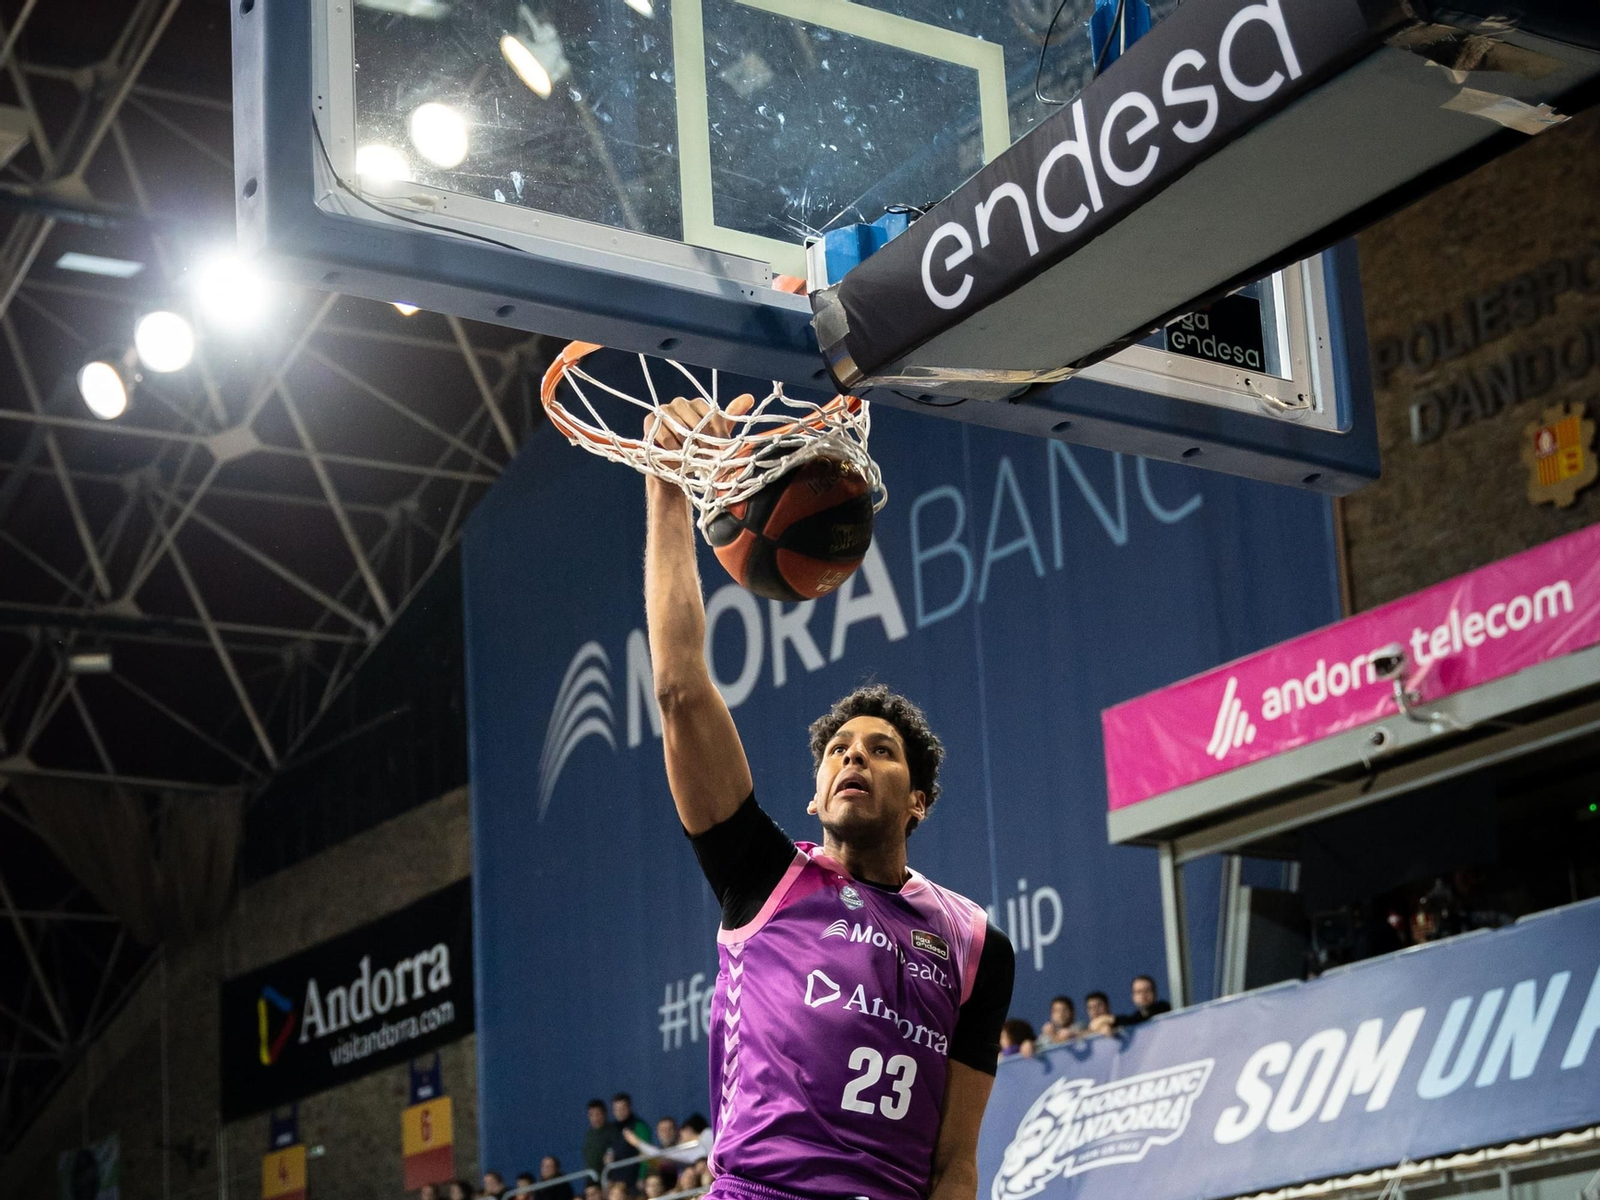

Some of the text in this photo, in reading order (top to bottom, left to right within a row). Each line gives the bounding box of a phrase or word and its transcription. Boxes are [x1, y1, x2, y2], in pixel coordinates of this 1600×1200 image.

[921, 0, 1302, 310] endesa
[1171, 331, 1260, 368] endesa
[1262, 580, 1574, 721] andorr telecom
[299, 942, 453, 1044] Andorra
[329, 1000, 456, 1068] visitandorra.com
[840, 1046, 918, 1121] 23
[1213, 1007, 1427, 1146] SOM
[1416, 970, 1572, 1100] UN
[1055, 1094, 1188, 1157] ANDORRA
